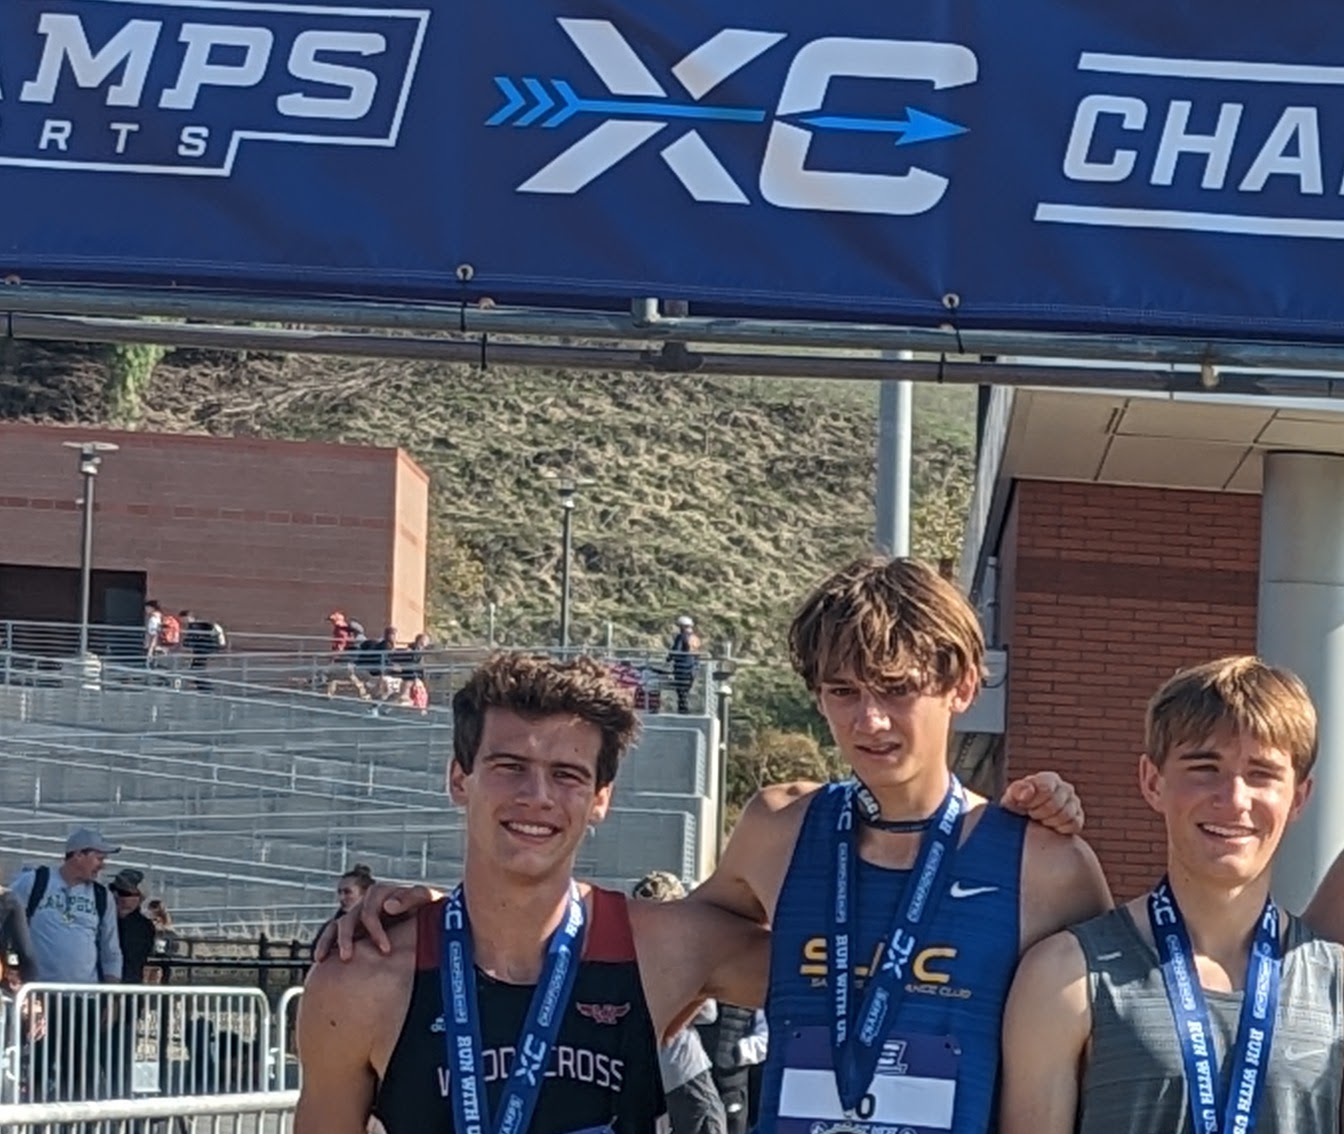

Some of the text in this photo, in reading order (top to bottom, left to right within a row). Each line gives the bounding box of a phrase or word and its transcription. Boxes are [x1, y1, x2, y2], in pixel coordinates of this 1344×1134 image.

[0, 14, 388, 120] MPS
[515, 17, 979, 215] XC
[457, 1035, 475, 1073] RUN
[1187, 1020, 1208, 1057] RUN
[1245, 1028, 1264, 1066] RUN
[461, 1075, 480, 1122] WITH
[1196, 1060, 1214, 1104] WITH
[1237, 1068, 1257, 1112] WITH
